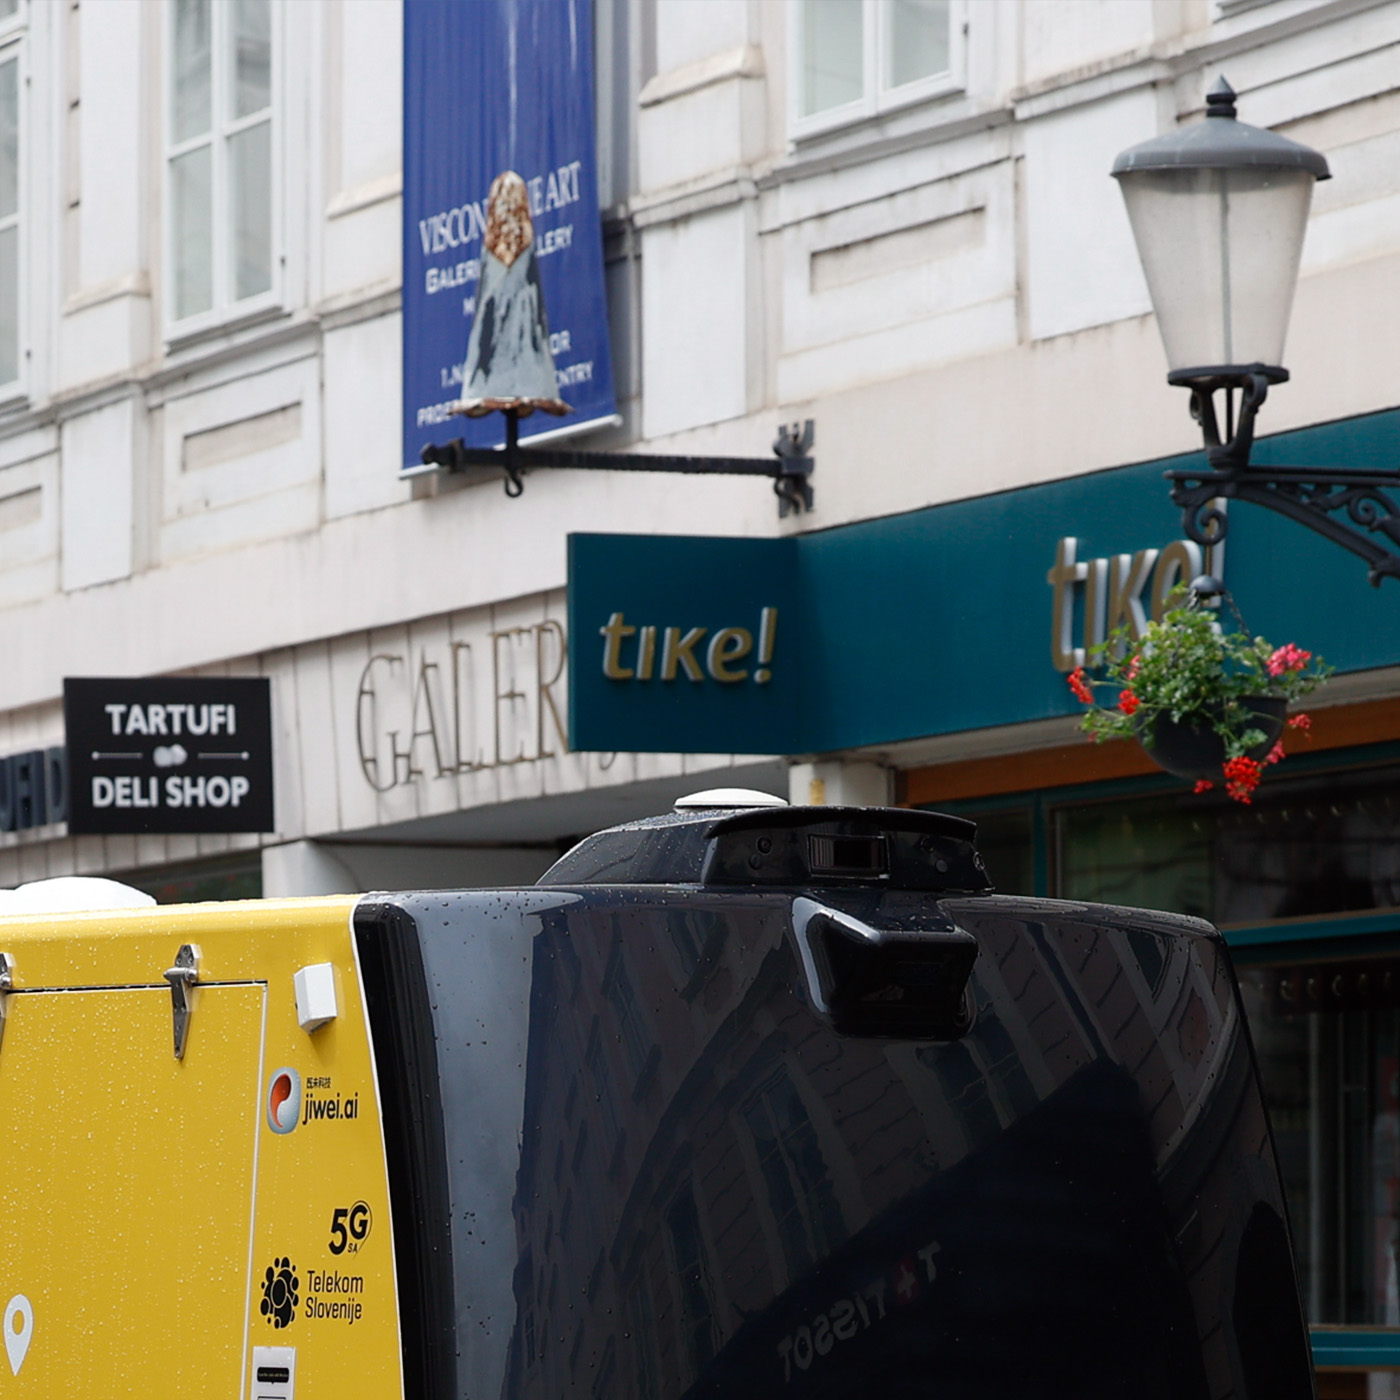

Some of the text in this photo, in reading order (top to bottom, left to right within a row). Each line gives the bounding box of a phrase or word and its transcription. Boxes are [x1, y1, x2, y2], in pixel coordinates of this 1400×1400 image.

[418, 197, 489, 256] VISCON
[545, 160, 582, 213] ART
[535, 225, 574, 258] LERY
[600, 606, 779, 684] tike!
[105, 703, 237, 736] TARTUFI
[356, 619, 569, 793] GALER
[92, 776, 159, 808] DELI
[165, 776, 250, 808] SHOP
[302, 1091, 358, 1126] jiwei.ai
[328, 1203, 369, 1255] 5G
[347, 1242, 358, 1254] SA
[306, 1269, 364, 1294] Telekom
[305, 1296, 363, 1325] Slovenije
